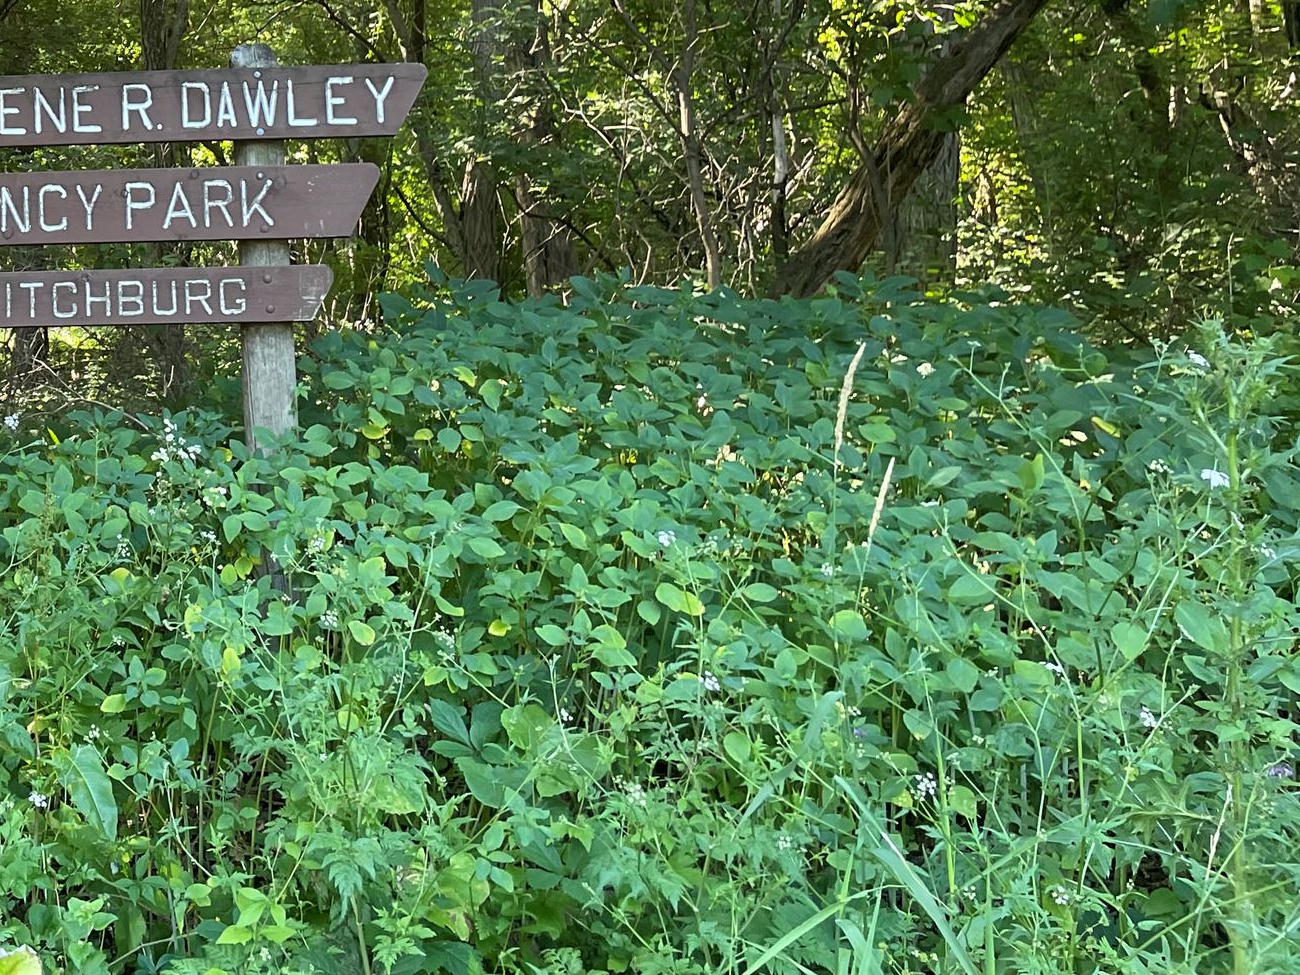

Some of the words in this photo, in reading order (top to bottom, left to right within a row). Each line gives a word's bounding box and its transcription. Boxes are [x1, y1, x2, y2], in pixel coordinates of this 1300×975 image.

[122, 83, 163, 131] R.
[180, 75, 395, 129] DAWLEY
[125, 178, 275, 231] PARK
